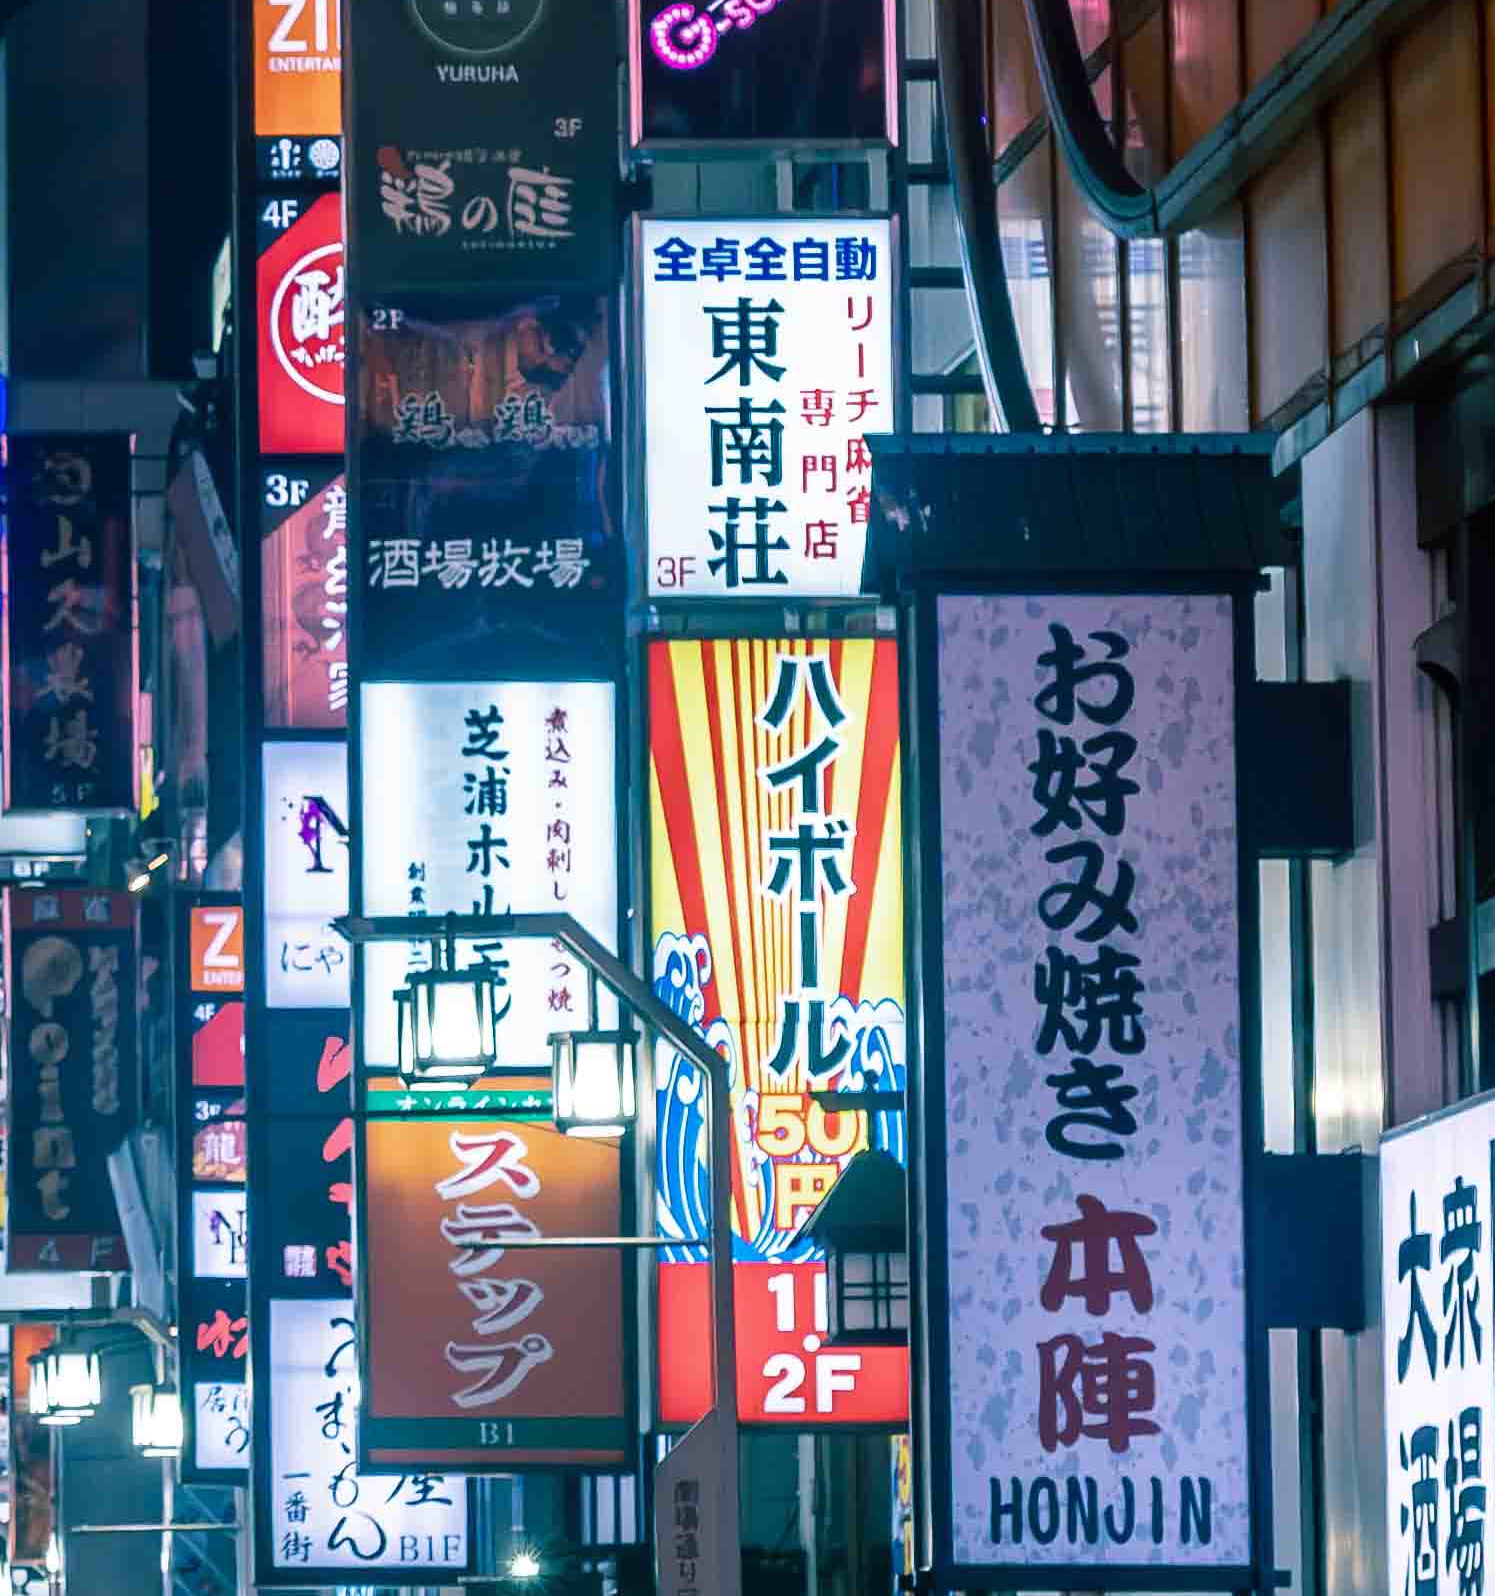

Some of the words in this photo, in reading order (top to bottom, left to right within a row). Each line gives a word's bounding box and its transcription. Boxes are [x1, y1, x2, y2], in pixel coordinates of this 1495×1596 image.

[436, 64, 519, 84] YURUHA
[261, 201, 298, 229] 4F
[652, 236, 878, 283] 全卓全自動
[703, 296, 790, 589] 東南荘
[798, 387, 839, 560] 専門店
[264, 473, 309, 506] 3F
[367, 538, 591, 589] 酒場牧場
[656, 556, 697, 589] 3F
[760, 653, 854, 1083] ハイボール
[1029, 622, 1146, 1161] お好み焼き
[435, 1129, 555, 1411] ステップ
[1396, 1173, 1485, 1385] 大衆
[1038, 1193, 1164, 1455] 本陣
[762, 1352, 863, 1415] 2F
[281, 1471, 313, 1563] 一番街
[399, 1533, 462, 1562] B1F
[987, 1474, 1214, 1548] HONJIN
